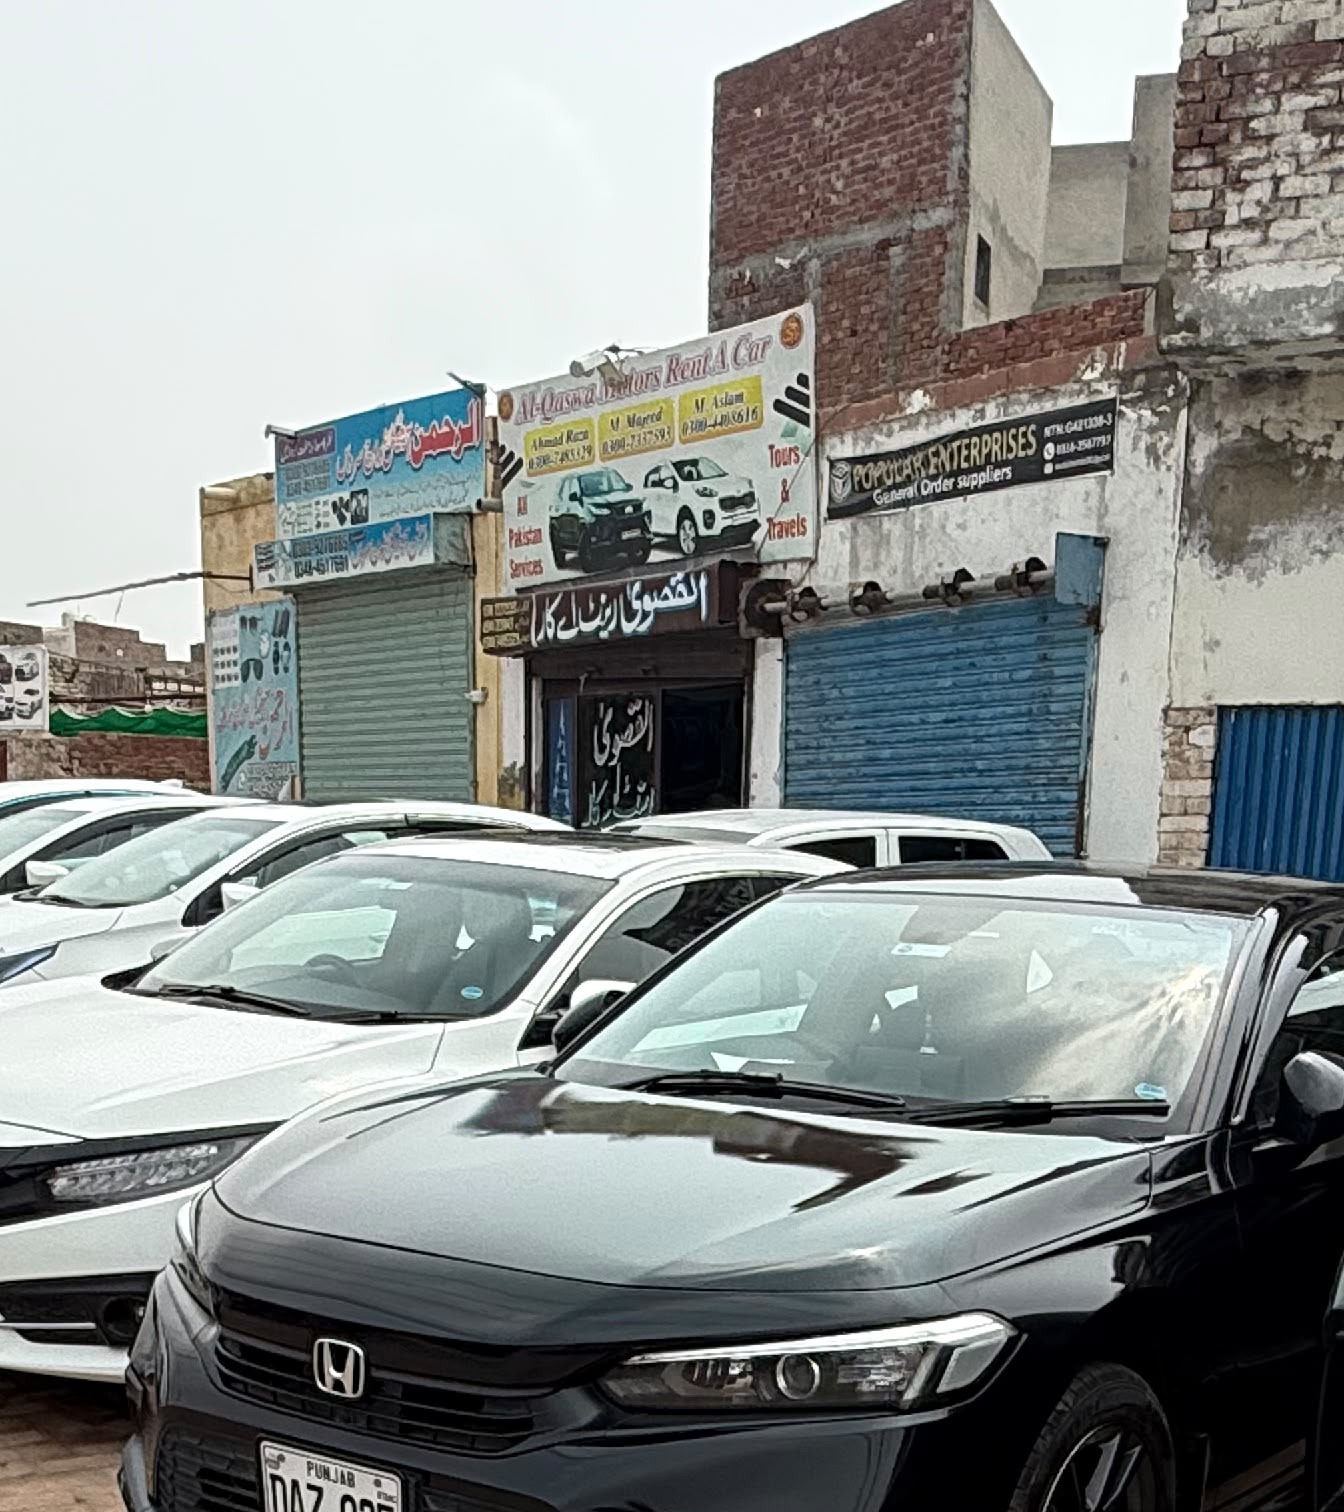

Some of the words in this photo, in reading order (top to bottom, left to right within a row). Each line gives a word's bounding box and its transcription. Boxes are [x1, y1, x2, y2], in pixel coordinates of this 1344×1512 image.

[662, 353, 708, 389] Rent
[706, 339, 730, 374] A
[731, 334, 773, 367] Car
[768, 444, 800, 468] Tours
[853, 450, 927, 491] POPULAR
[928, 423, 1038, 474] ENTERPRISES
[781, 478, 790, 503] &
[872, 480, 919, 505] General
[920, 474, 956, 496] Order
[956, 464, 1013, 490] suppliers
[509, 525, 543, 548] Pakistan
[766, 512, 808, 541] Travels
[509, 555, 544, 579] Services
[306, 1460, 356, 1489] PUNJAB
